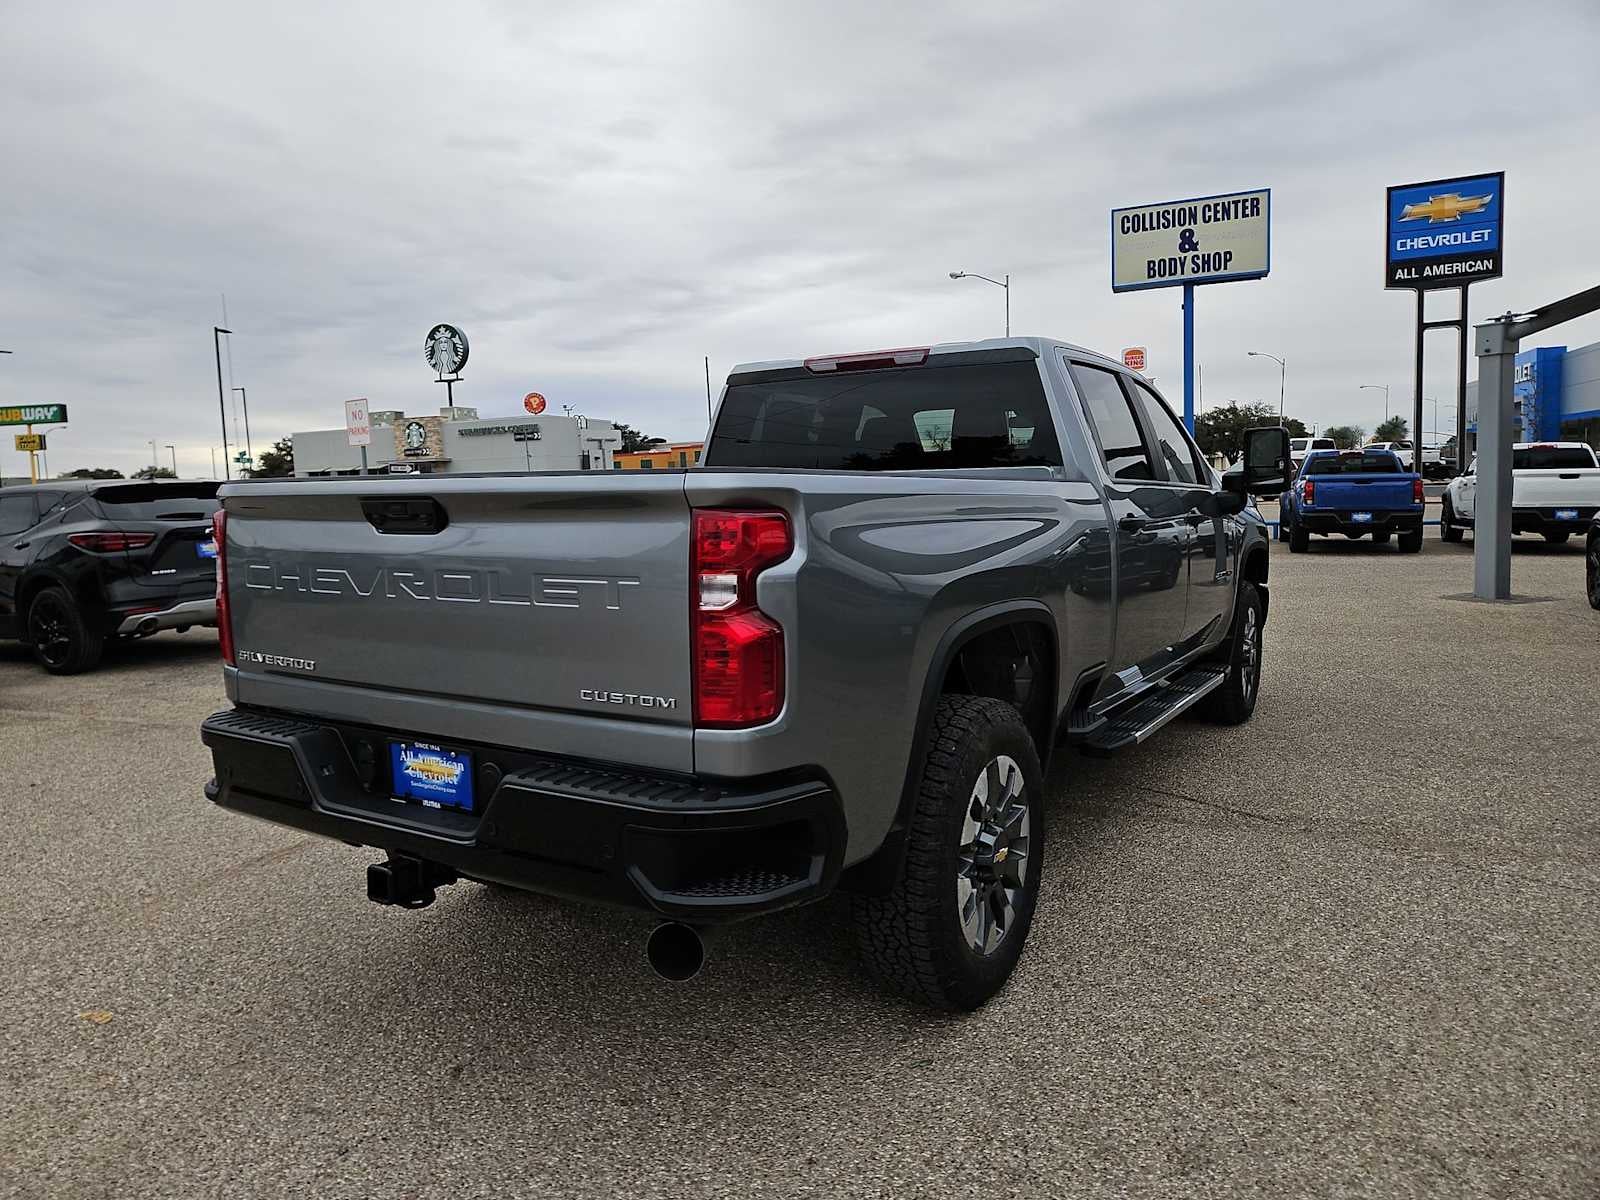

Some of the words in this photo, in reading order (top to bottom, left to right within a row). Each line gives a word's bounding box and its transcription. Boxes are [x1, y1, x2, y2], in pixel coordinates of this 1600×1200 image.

[1121, 206, 1198, 235] COLLISION
[1202, 197, 1261, 224] CENTER
[1178, 228, 1199, 253] &
[1396, 229, 1492, 251] CHEVROLET
[1147, 256, 1187, 279] BODY
[1191, 250, 1233, 274] SHOP
[1395, 267, 1419, 280] ALL
[1423, 259, 1493, 277] AMERICAN
[352, 410, 363, 421] NO
[245, 563, 641, 610] CHEVROLET
[239, 650, 316, 671] SILVERADO
[580, 689, 677, 709] CUSTOM
[400, 750, 414, 762] All
[417, 753, 465, 772] American
[408, 766, 459, 785] Chevrolet
